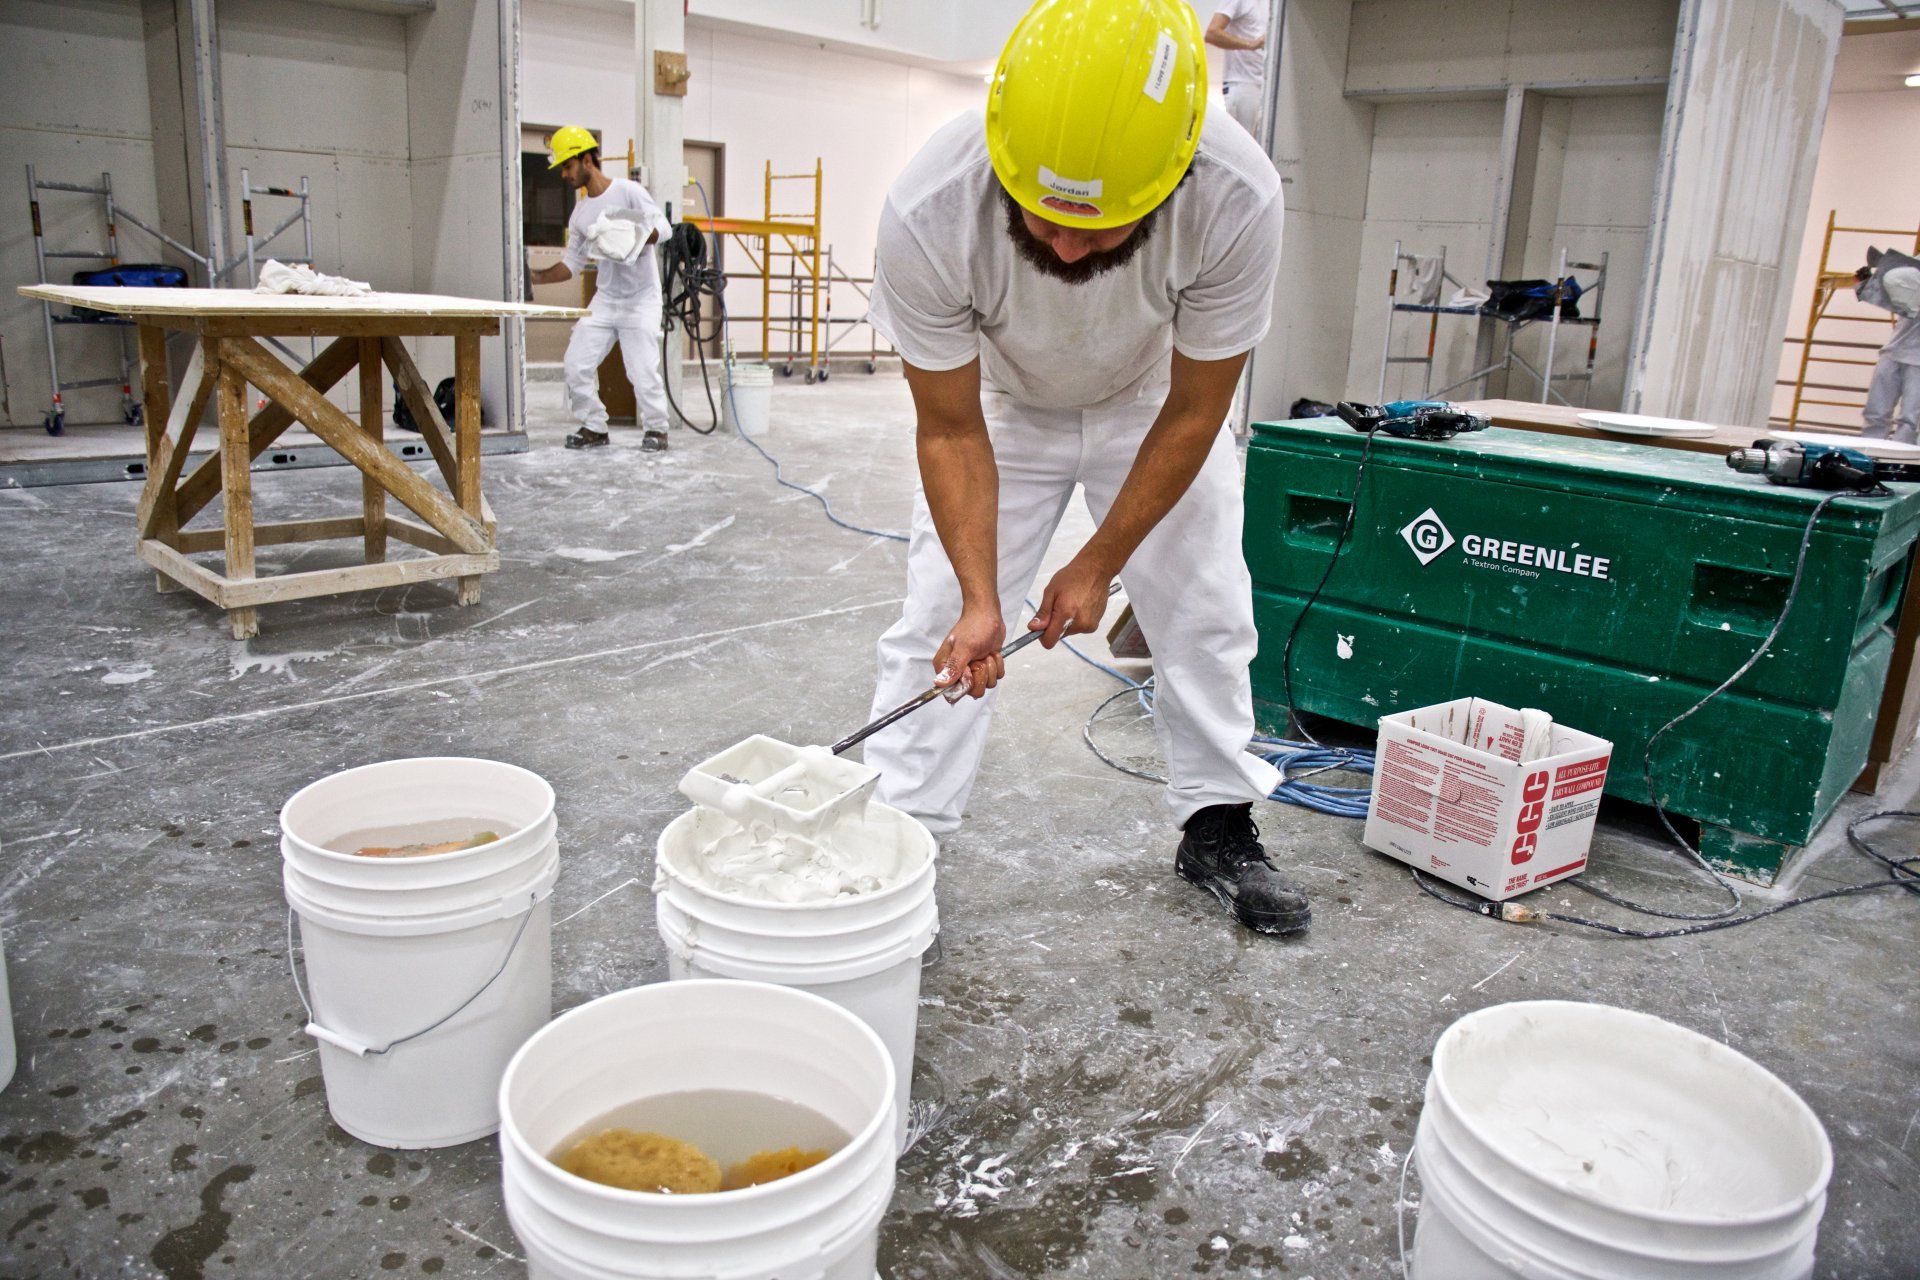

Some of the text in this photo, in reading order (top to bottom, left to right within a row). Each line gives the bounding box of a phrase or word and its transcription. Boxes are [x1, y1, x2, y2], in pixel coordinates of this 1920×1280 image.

[1050, 182, 1089, 196] Jordan
[1416, 524, 1438, 549] G
[1462, 534, 1611, 580] GREENLEE
[1463, 557, 1540, 580] A Textron Company
[1510, 770, 1550, 866] CGC
